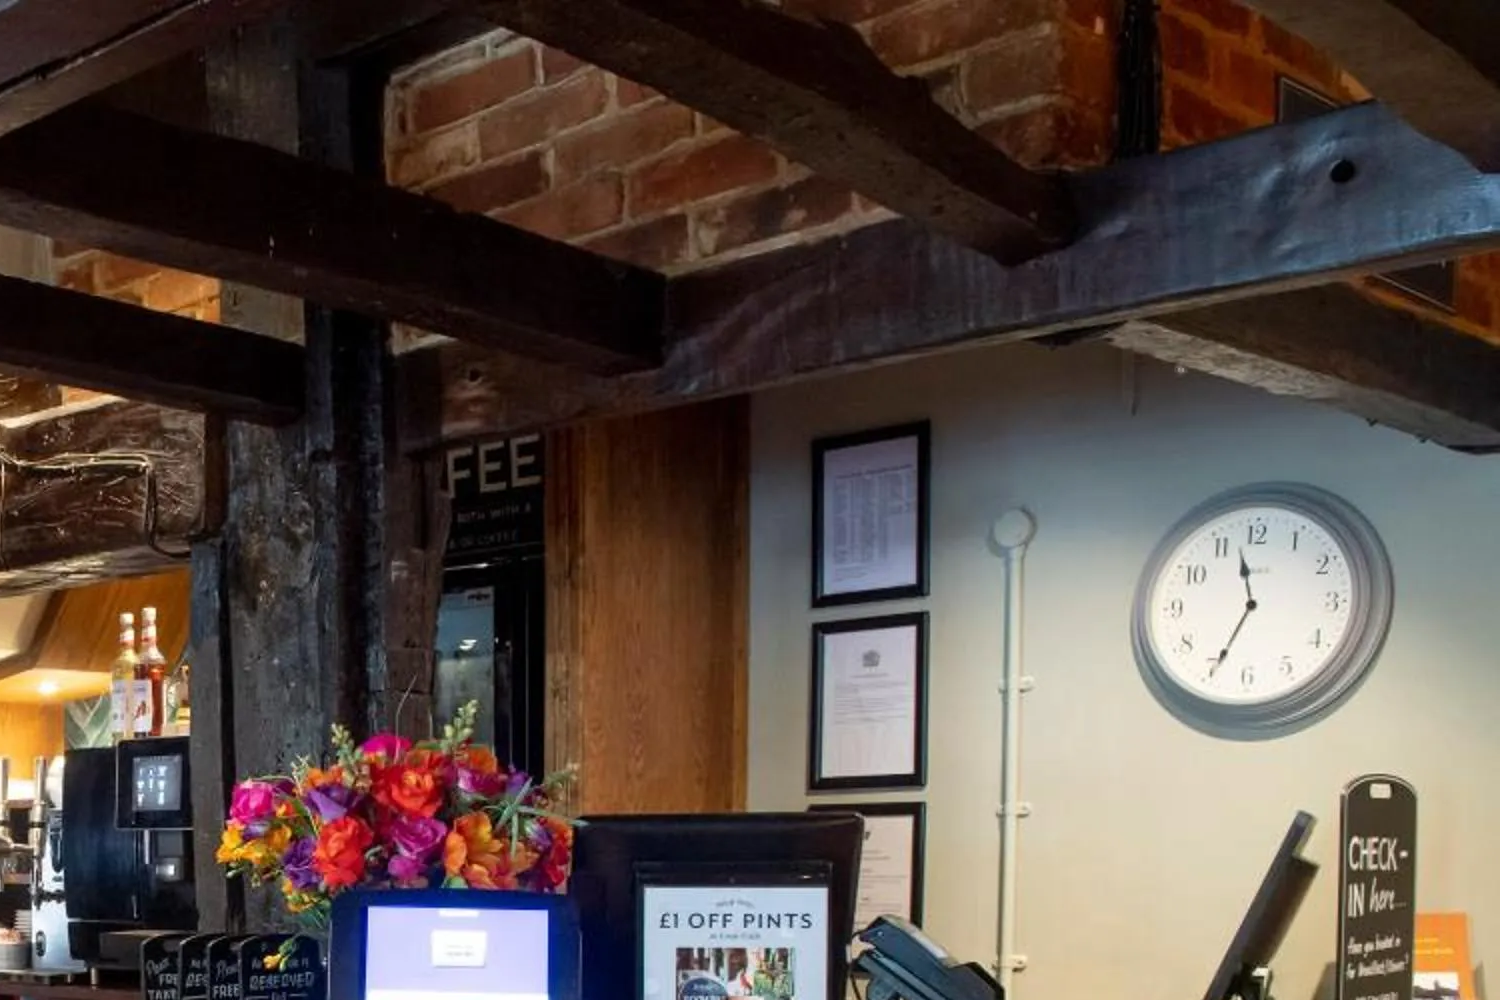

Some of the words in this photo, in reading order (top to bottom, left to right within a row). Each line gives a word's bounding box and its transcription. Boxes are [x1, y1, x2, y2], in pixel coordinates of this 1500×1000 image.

[1247, 524, 1267, 545] 12
[1292, 530, 1299, 551] 1
[1214, 536, 1228, 558] 11
[1186, 564, 1207, 585] 10
[1316, 554, 1330, 575] 2
[1169, 599, 1184, 619] 9
[1325, 591, 1340, 612] 3
[1179, 633, 1194, 654] 8
[1308, 628, 1322, 649] 4
[1279, 655, 1293, 675] 5
[1240, 666, 1255, 687] 6
[1348, 883, 1366, 918] IN
[660, 913, 679, 929] £1
[688, 913, 733, 929] OFF
[743, 913, 813, 929] PINTS
